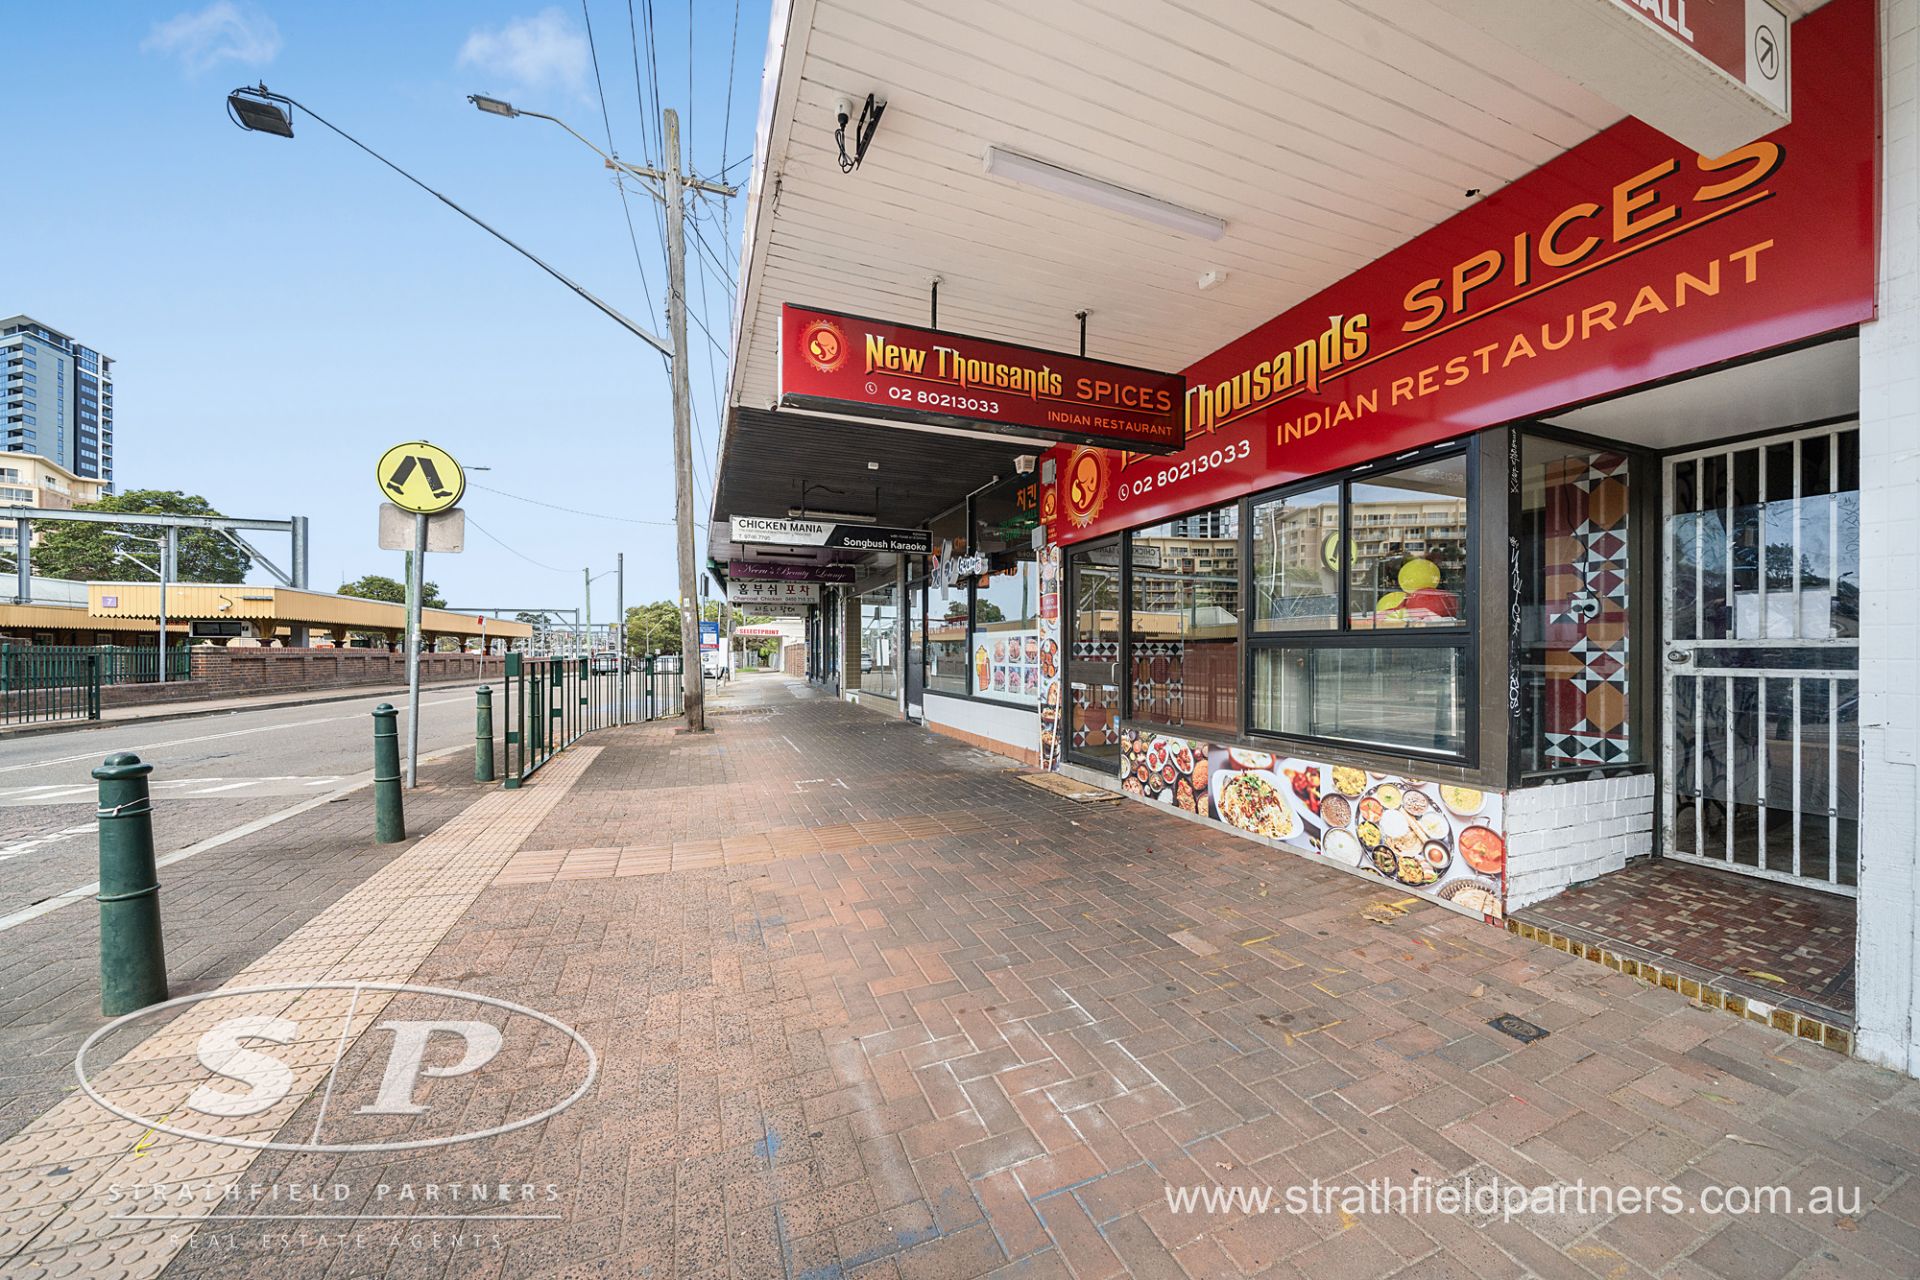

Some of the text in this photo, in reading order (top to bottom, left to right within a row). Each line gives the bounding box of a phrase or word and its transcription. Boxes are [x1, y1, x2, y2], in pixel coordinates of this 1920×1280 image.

[1401, 141, 1783, 332] SPICES
[1277, 238, 1775, 446] INDIAN RESTAURANT
[865, 333, 1172, 411] New Thousands SPICES
[888, 386, 999, 414] 02 80213033
[1047, 411, 1173, 436] INDIAN RESTAURANT
[1132, 477, 1153, 495] 02
[1157, 439, 1251, 487] 80213033
[738, 519, 787, 531] CHICKEN
[790, 523, 823, 533] MANIA
[843, 537, 888, 549] Songbush
[890, 540, 927, 551] Karaoke
